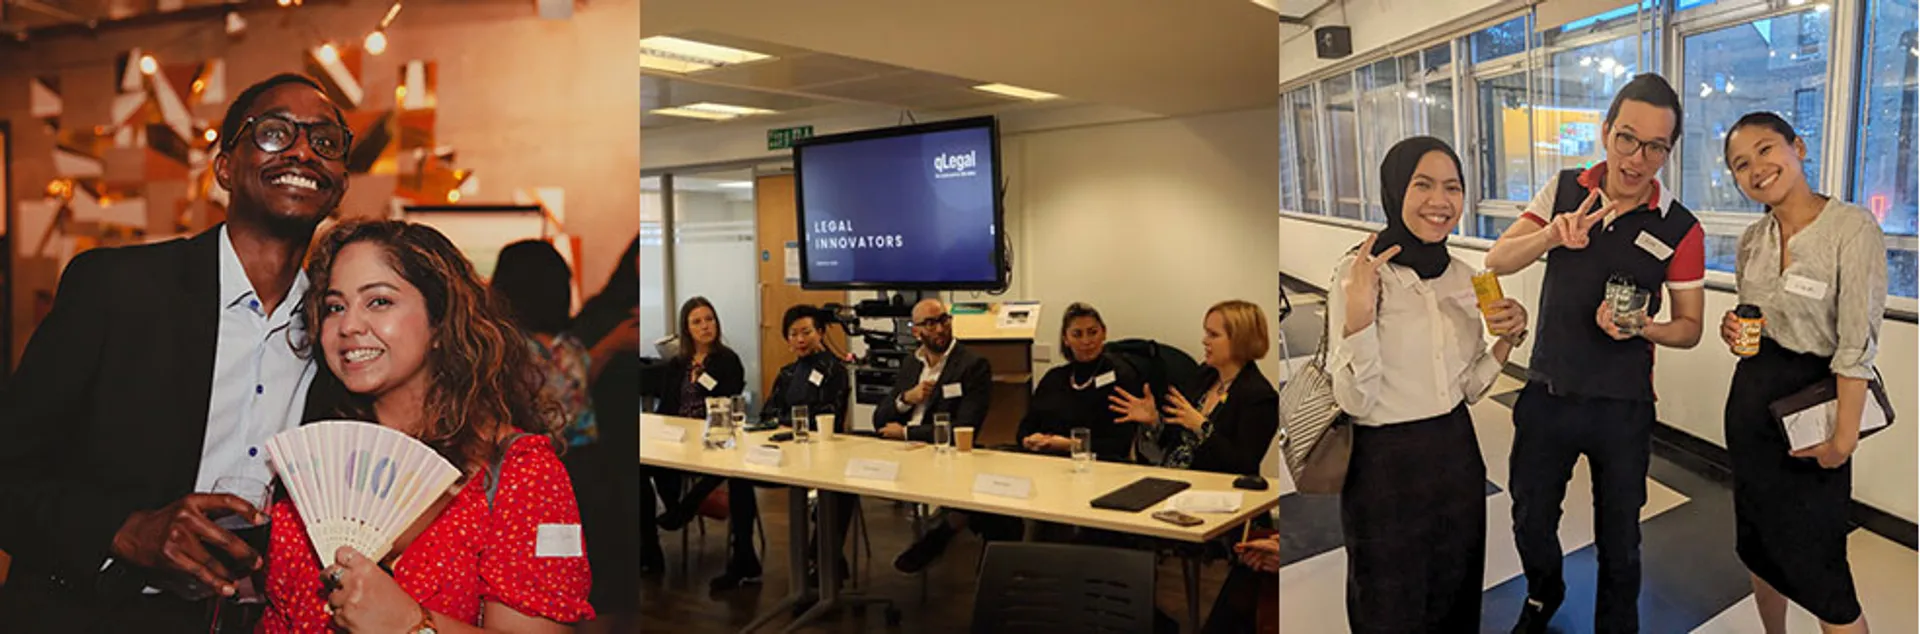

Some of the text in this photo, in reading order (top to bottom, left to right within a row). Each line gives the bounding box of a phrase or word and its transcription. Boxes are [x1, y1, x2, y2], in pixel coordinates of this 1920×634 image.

[934, 150, 976, 172] qLegal
[814, 220, 853, 233] LEGAL
[814, 234, 904, 250] INNOVATORS
